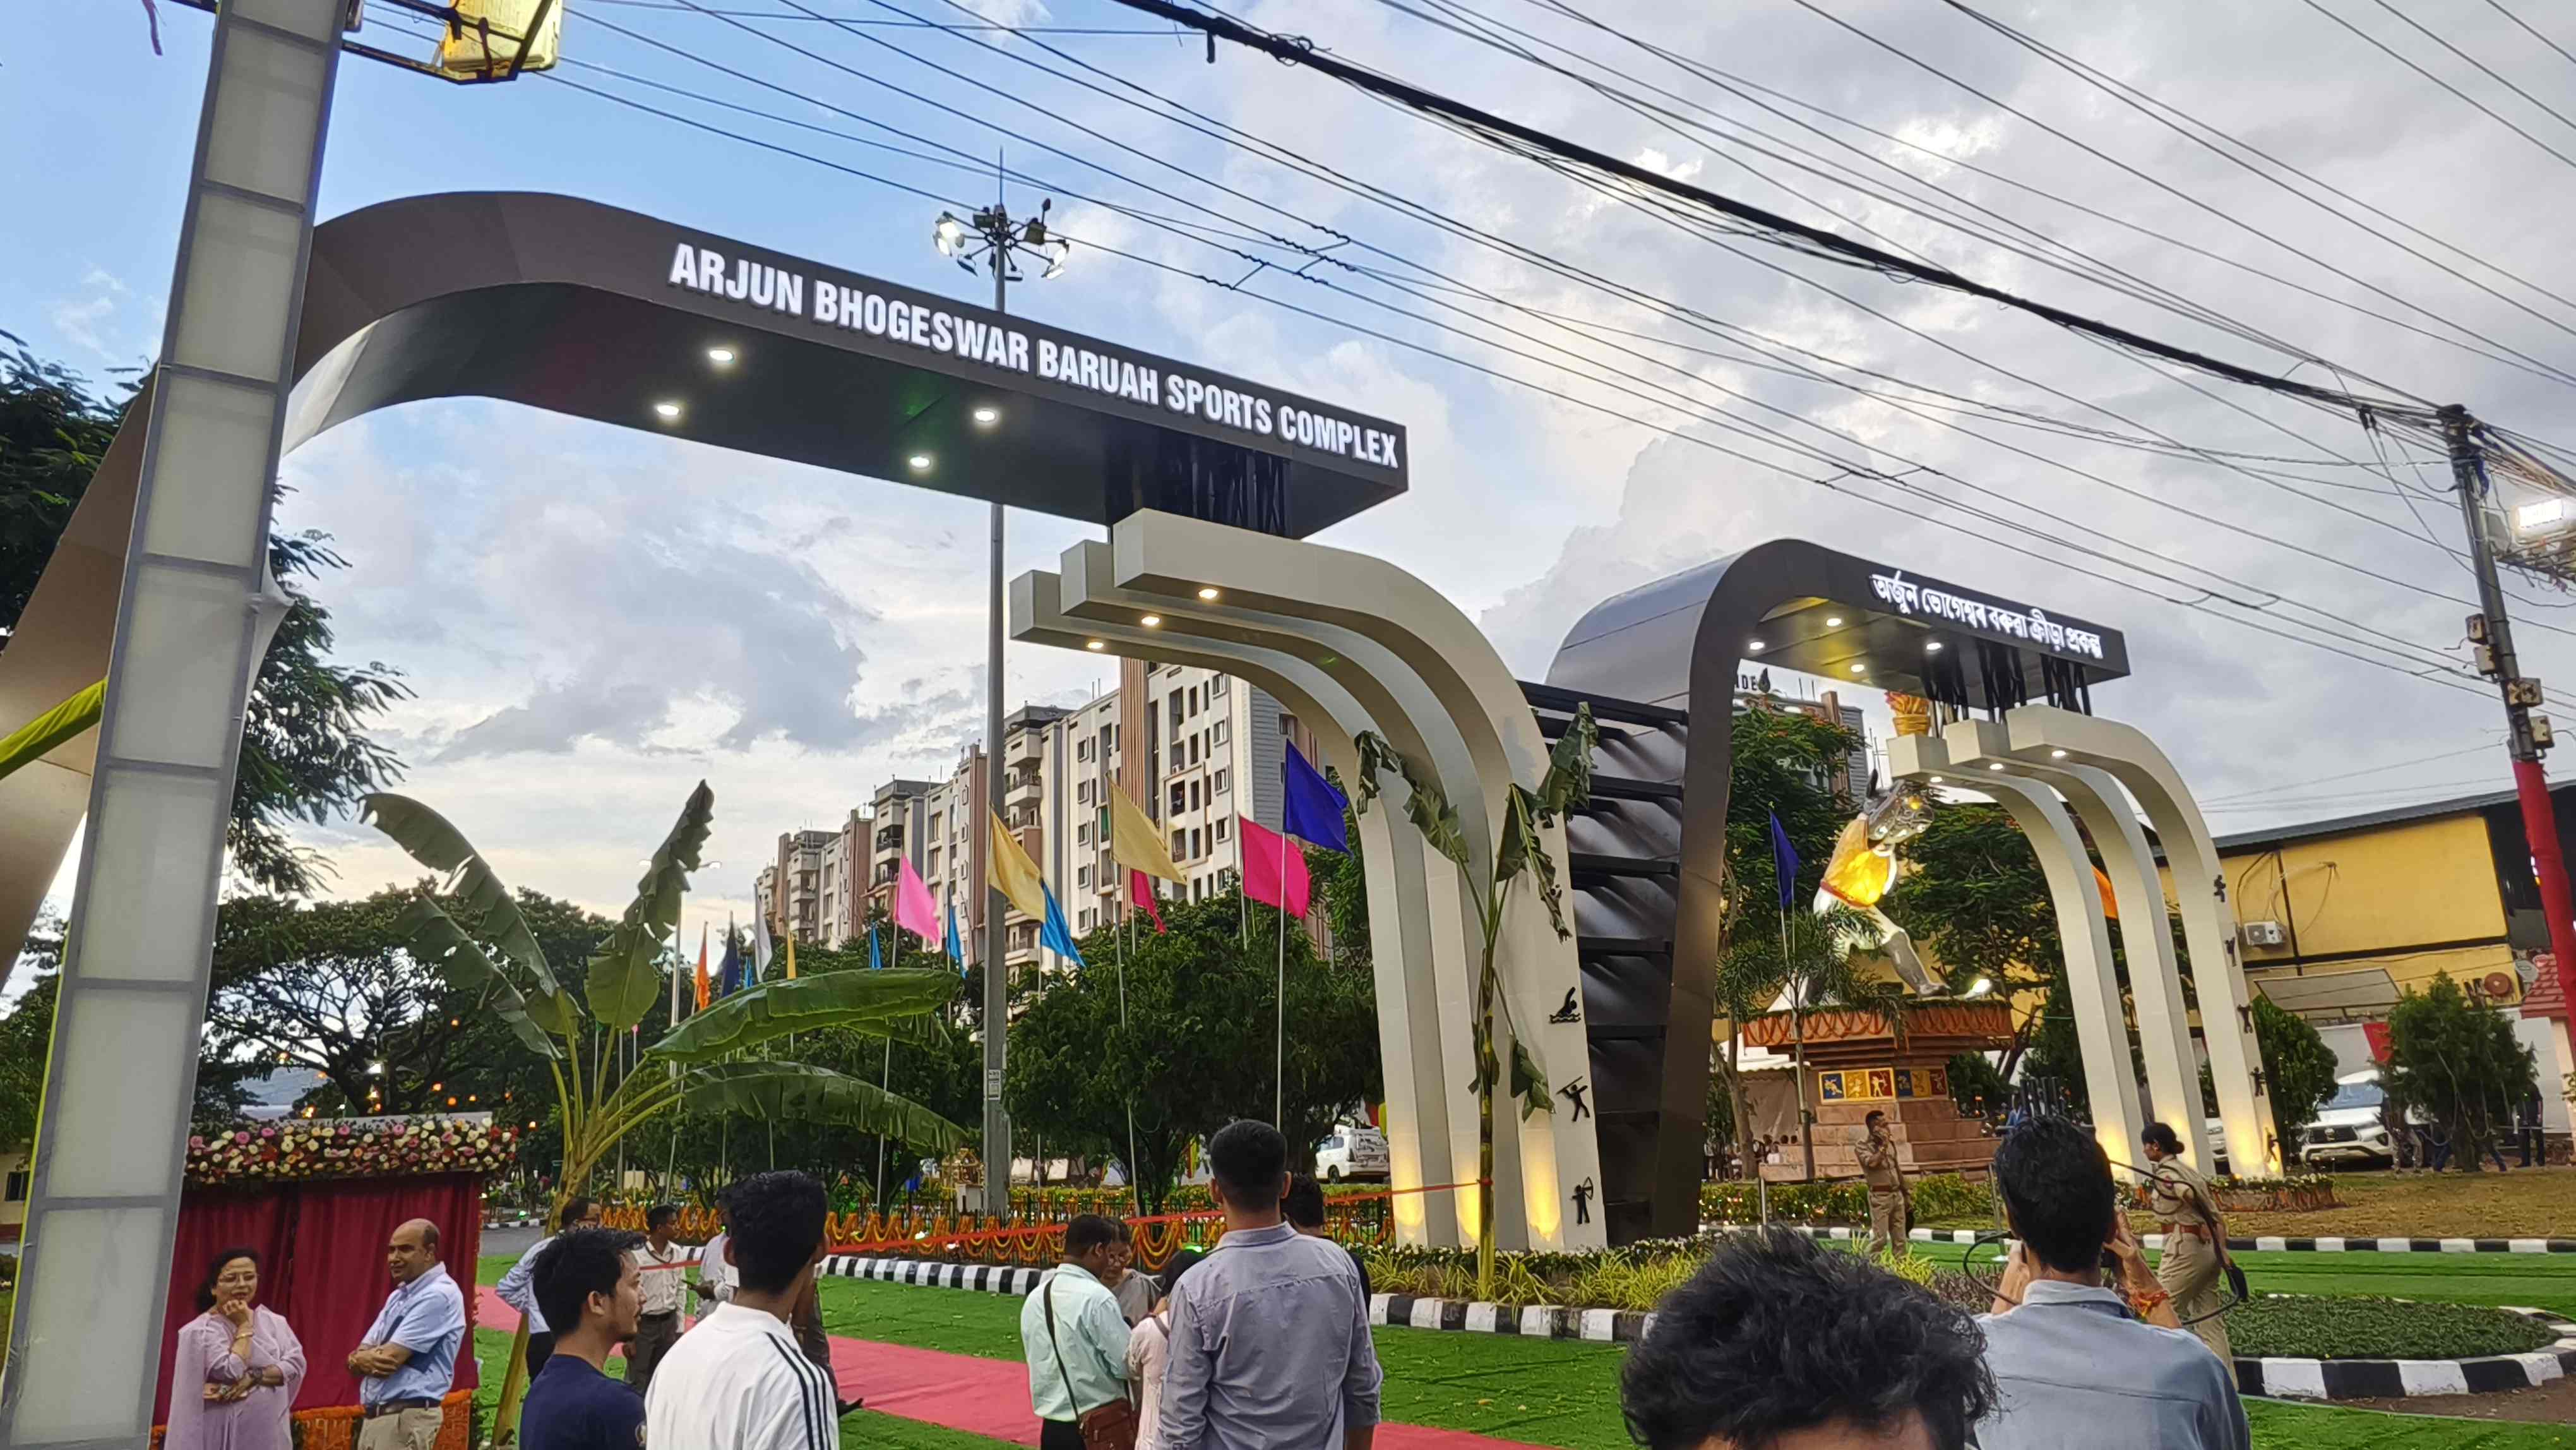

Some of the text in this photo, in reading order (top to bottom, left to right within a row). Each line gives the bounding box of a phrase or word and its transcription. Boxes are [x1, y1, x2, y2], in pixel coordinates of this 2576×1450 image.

[668, 243, 1398, 469] ARJUN BHOGESWAR BARUAH SPORTS COMPLEX
